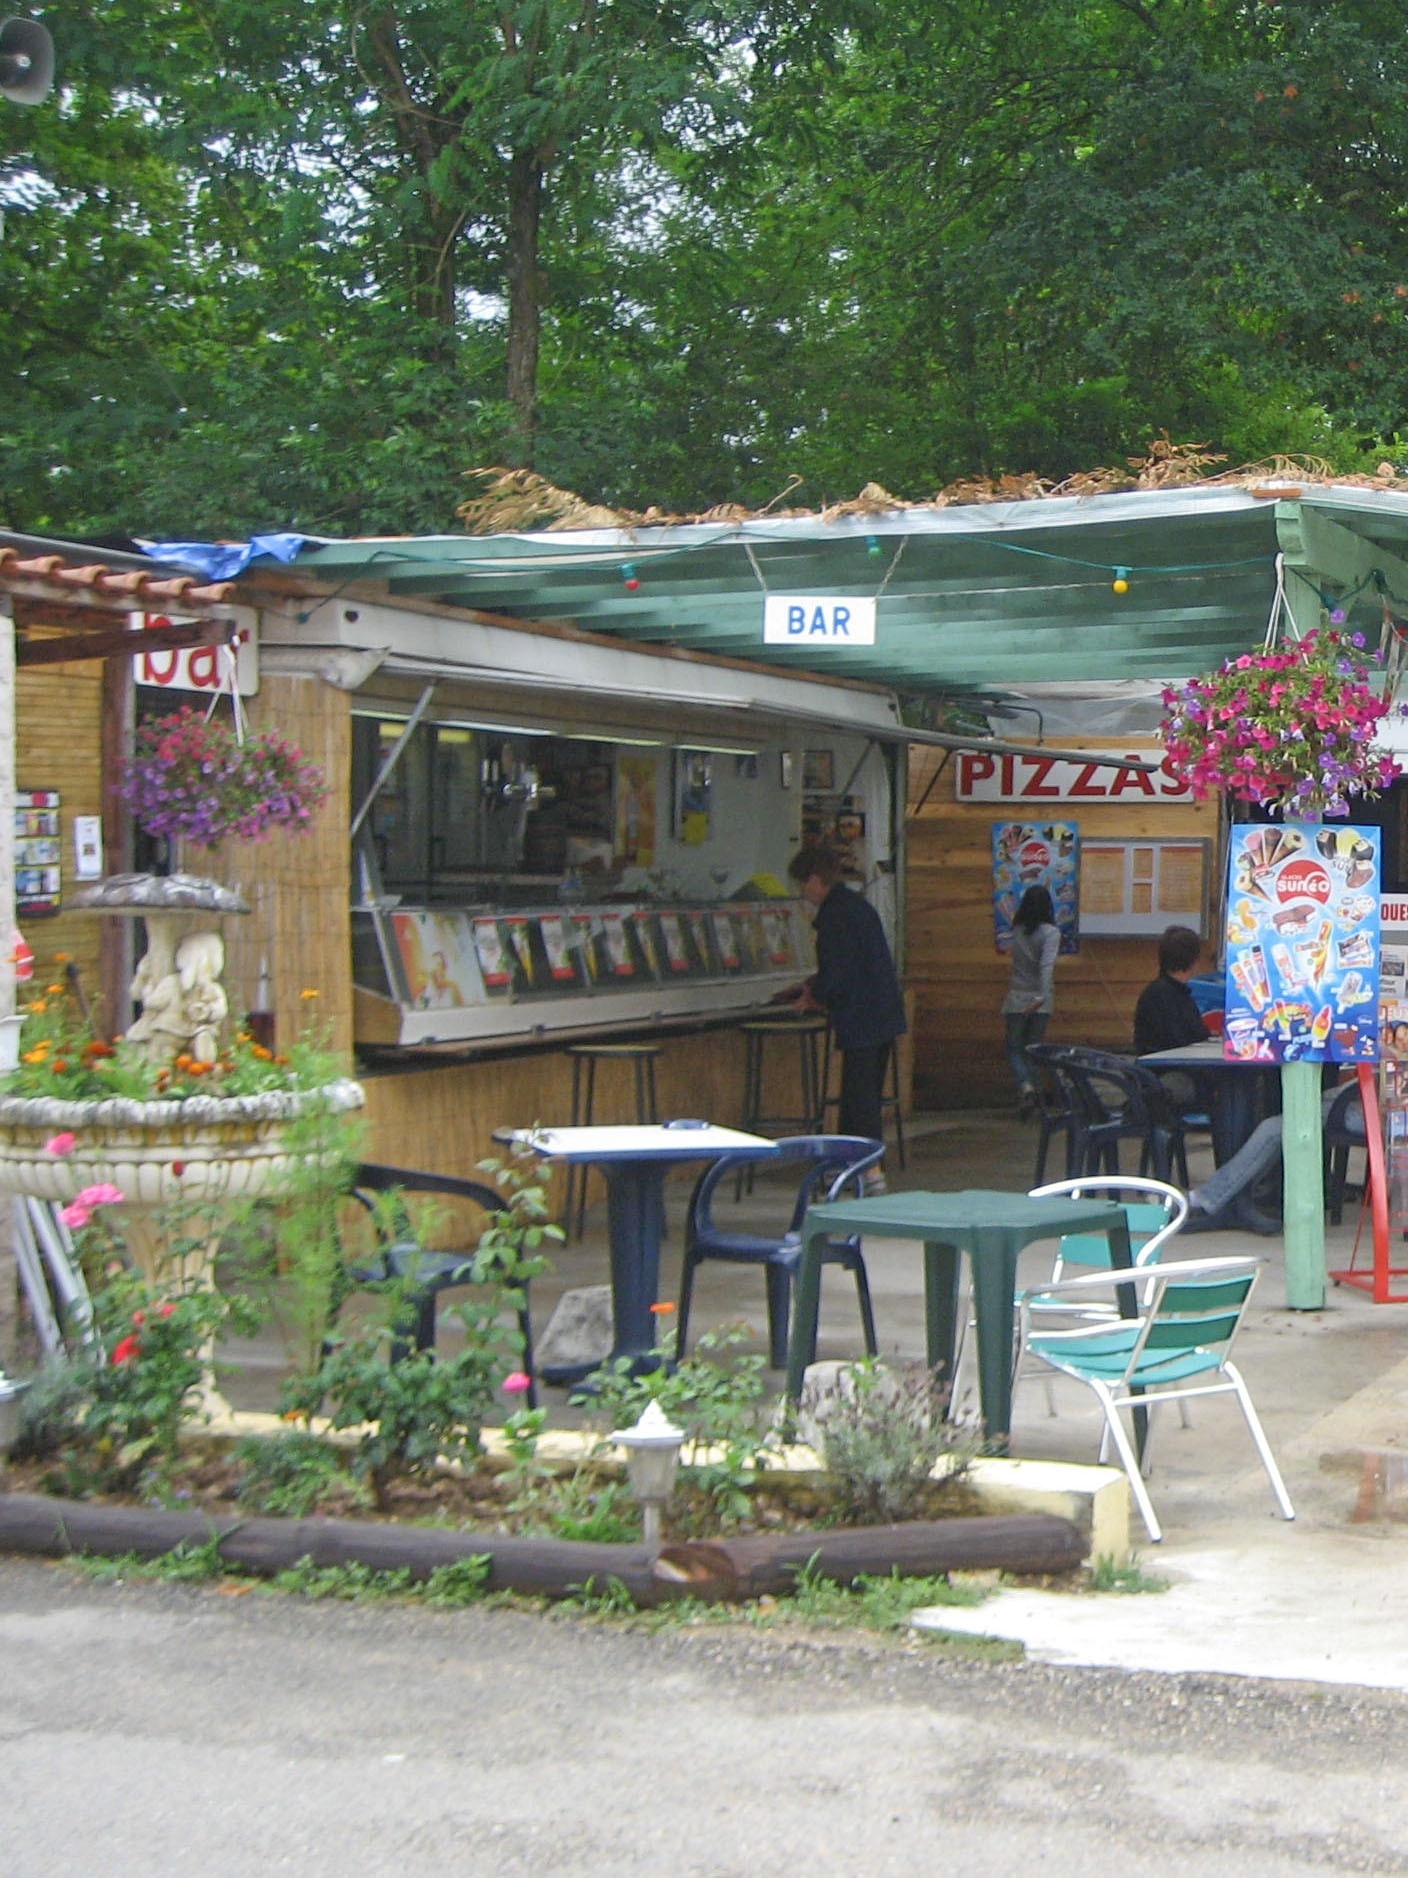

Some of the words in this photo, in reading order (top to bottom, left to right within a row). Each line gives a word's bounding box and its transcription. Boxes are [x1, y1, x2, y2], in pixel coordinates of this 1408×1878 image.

[788, 605, 850, 635] BAR
[143, 610, 249, 688] ba
[961, 754, 1190, 796] PIZZAS
